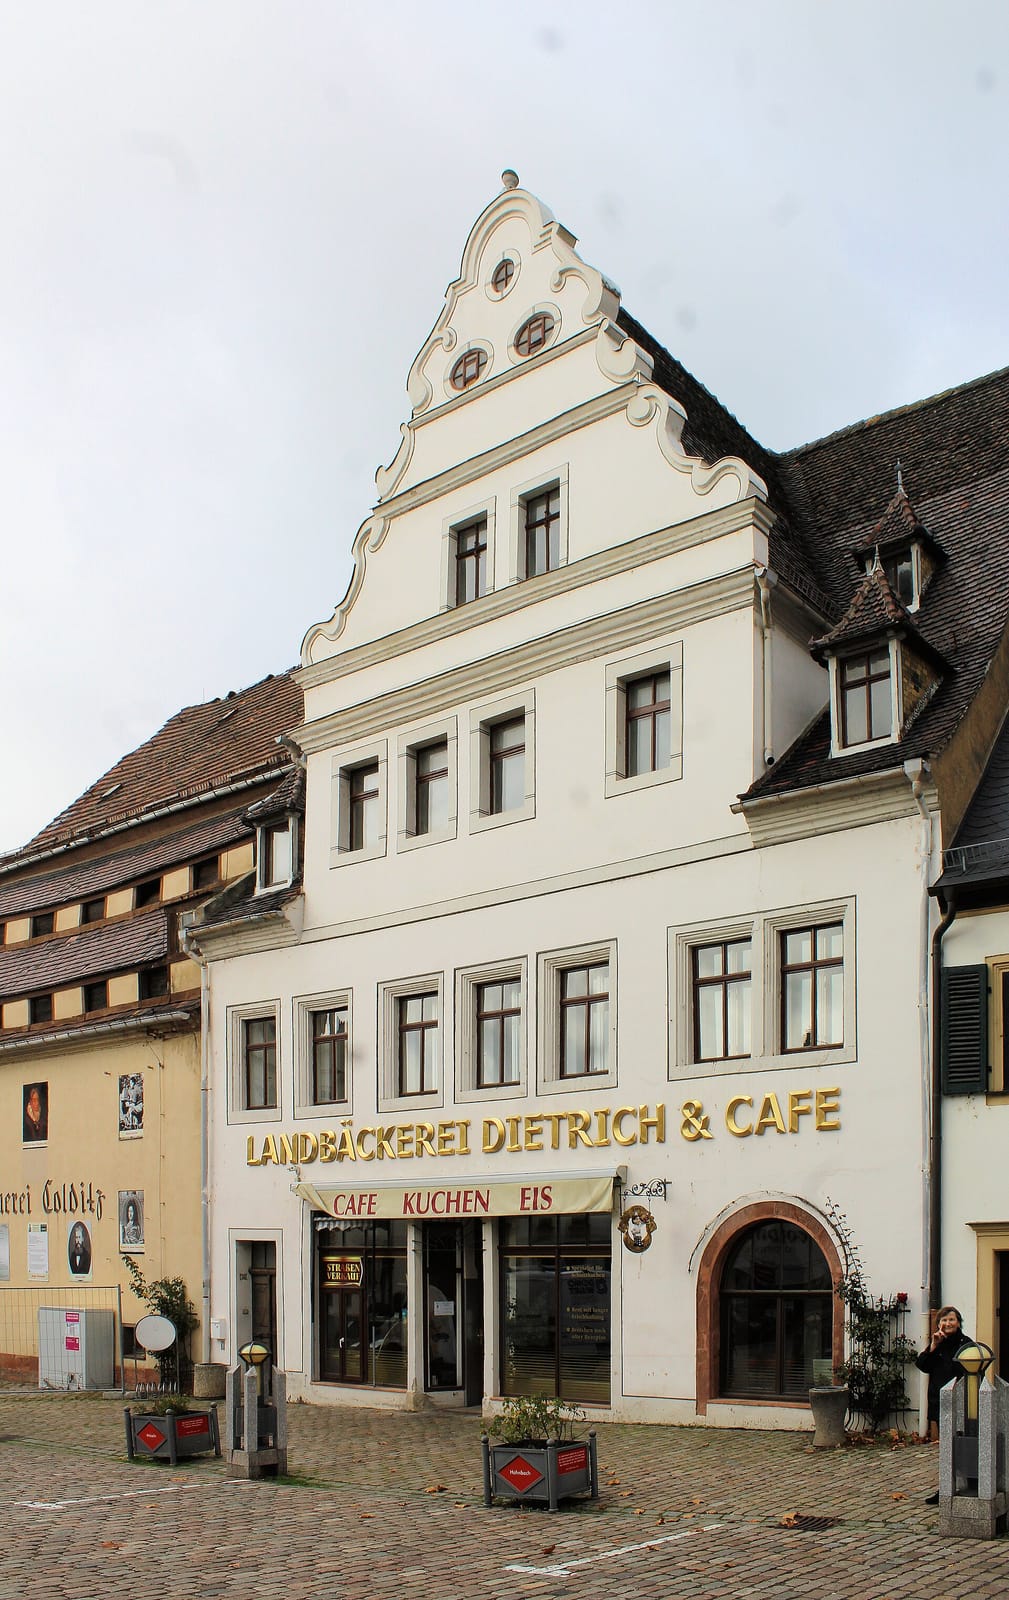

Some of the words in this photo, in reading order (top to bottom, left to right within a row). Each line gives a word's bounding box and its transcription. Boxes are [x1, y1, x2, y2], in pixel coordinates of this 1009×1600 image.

[246, 1120, 471, 1167] LANDBÄCKEREI
[481, 1104, 665, 1153] DIETRICH
[680, 1099, 713, 1142] &
[724, 1086, 842, 1138] CAFE
[42, 1179, 106, 1222] Colditz
[332, 1193, 378, 1217] CAFE
[401, 1189, 490, 1217] KUCHEN
[518, 1186, 553, 1213] EIS
